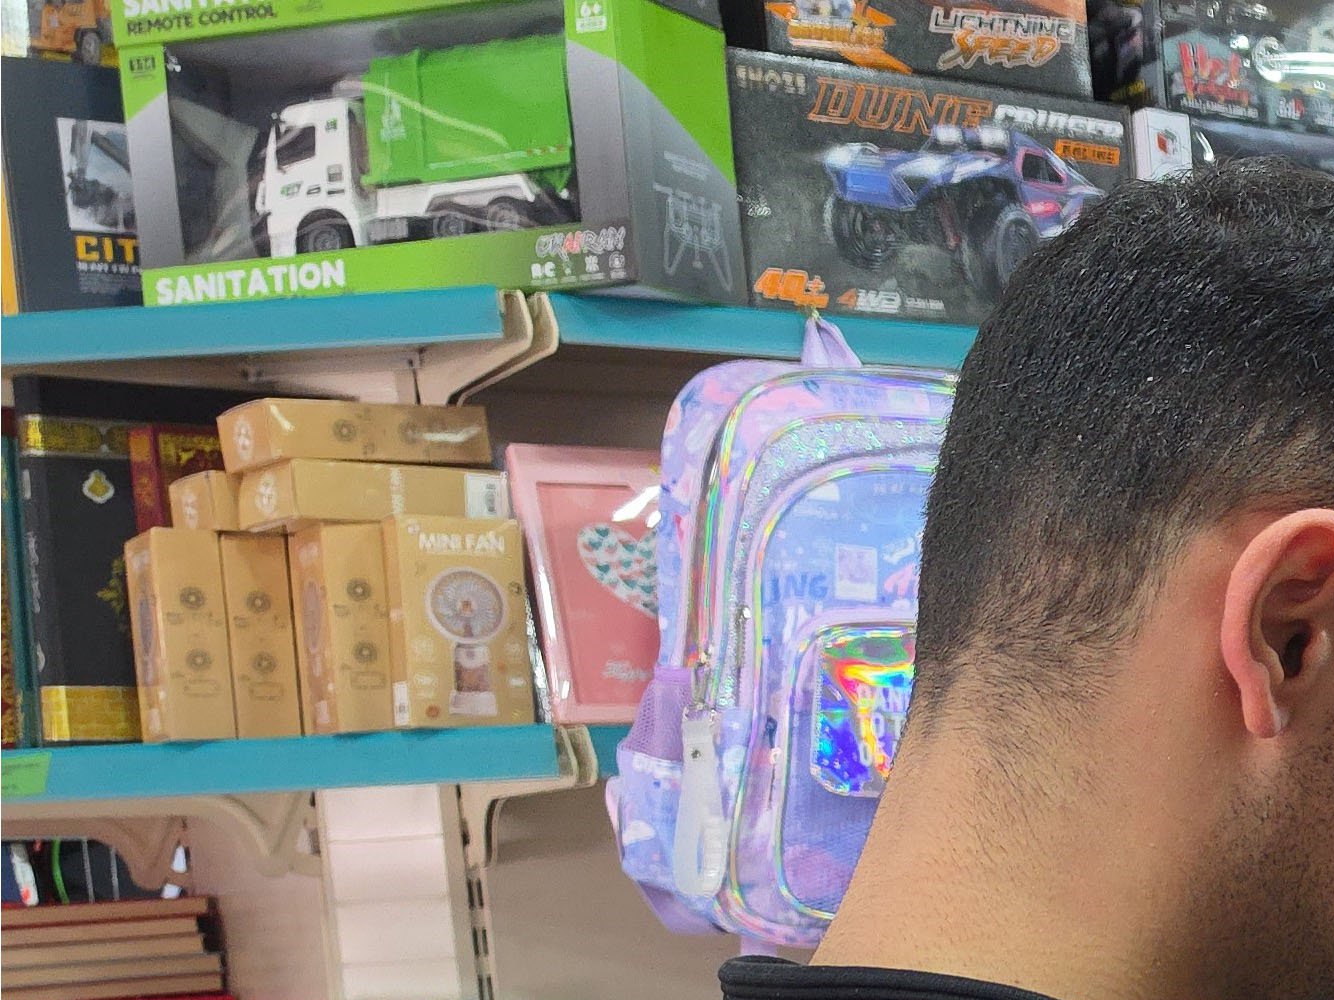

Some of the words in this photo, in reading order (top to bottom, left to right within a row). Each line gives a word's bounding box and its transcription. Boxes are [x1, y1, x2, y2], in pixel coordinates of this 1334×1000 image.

[127, 13, 193, 36] REMOTE
[199, 4, 275, 25] CONTROL
[155, 260, 345, 306] SANITATION
